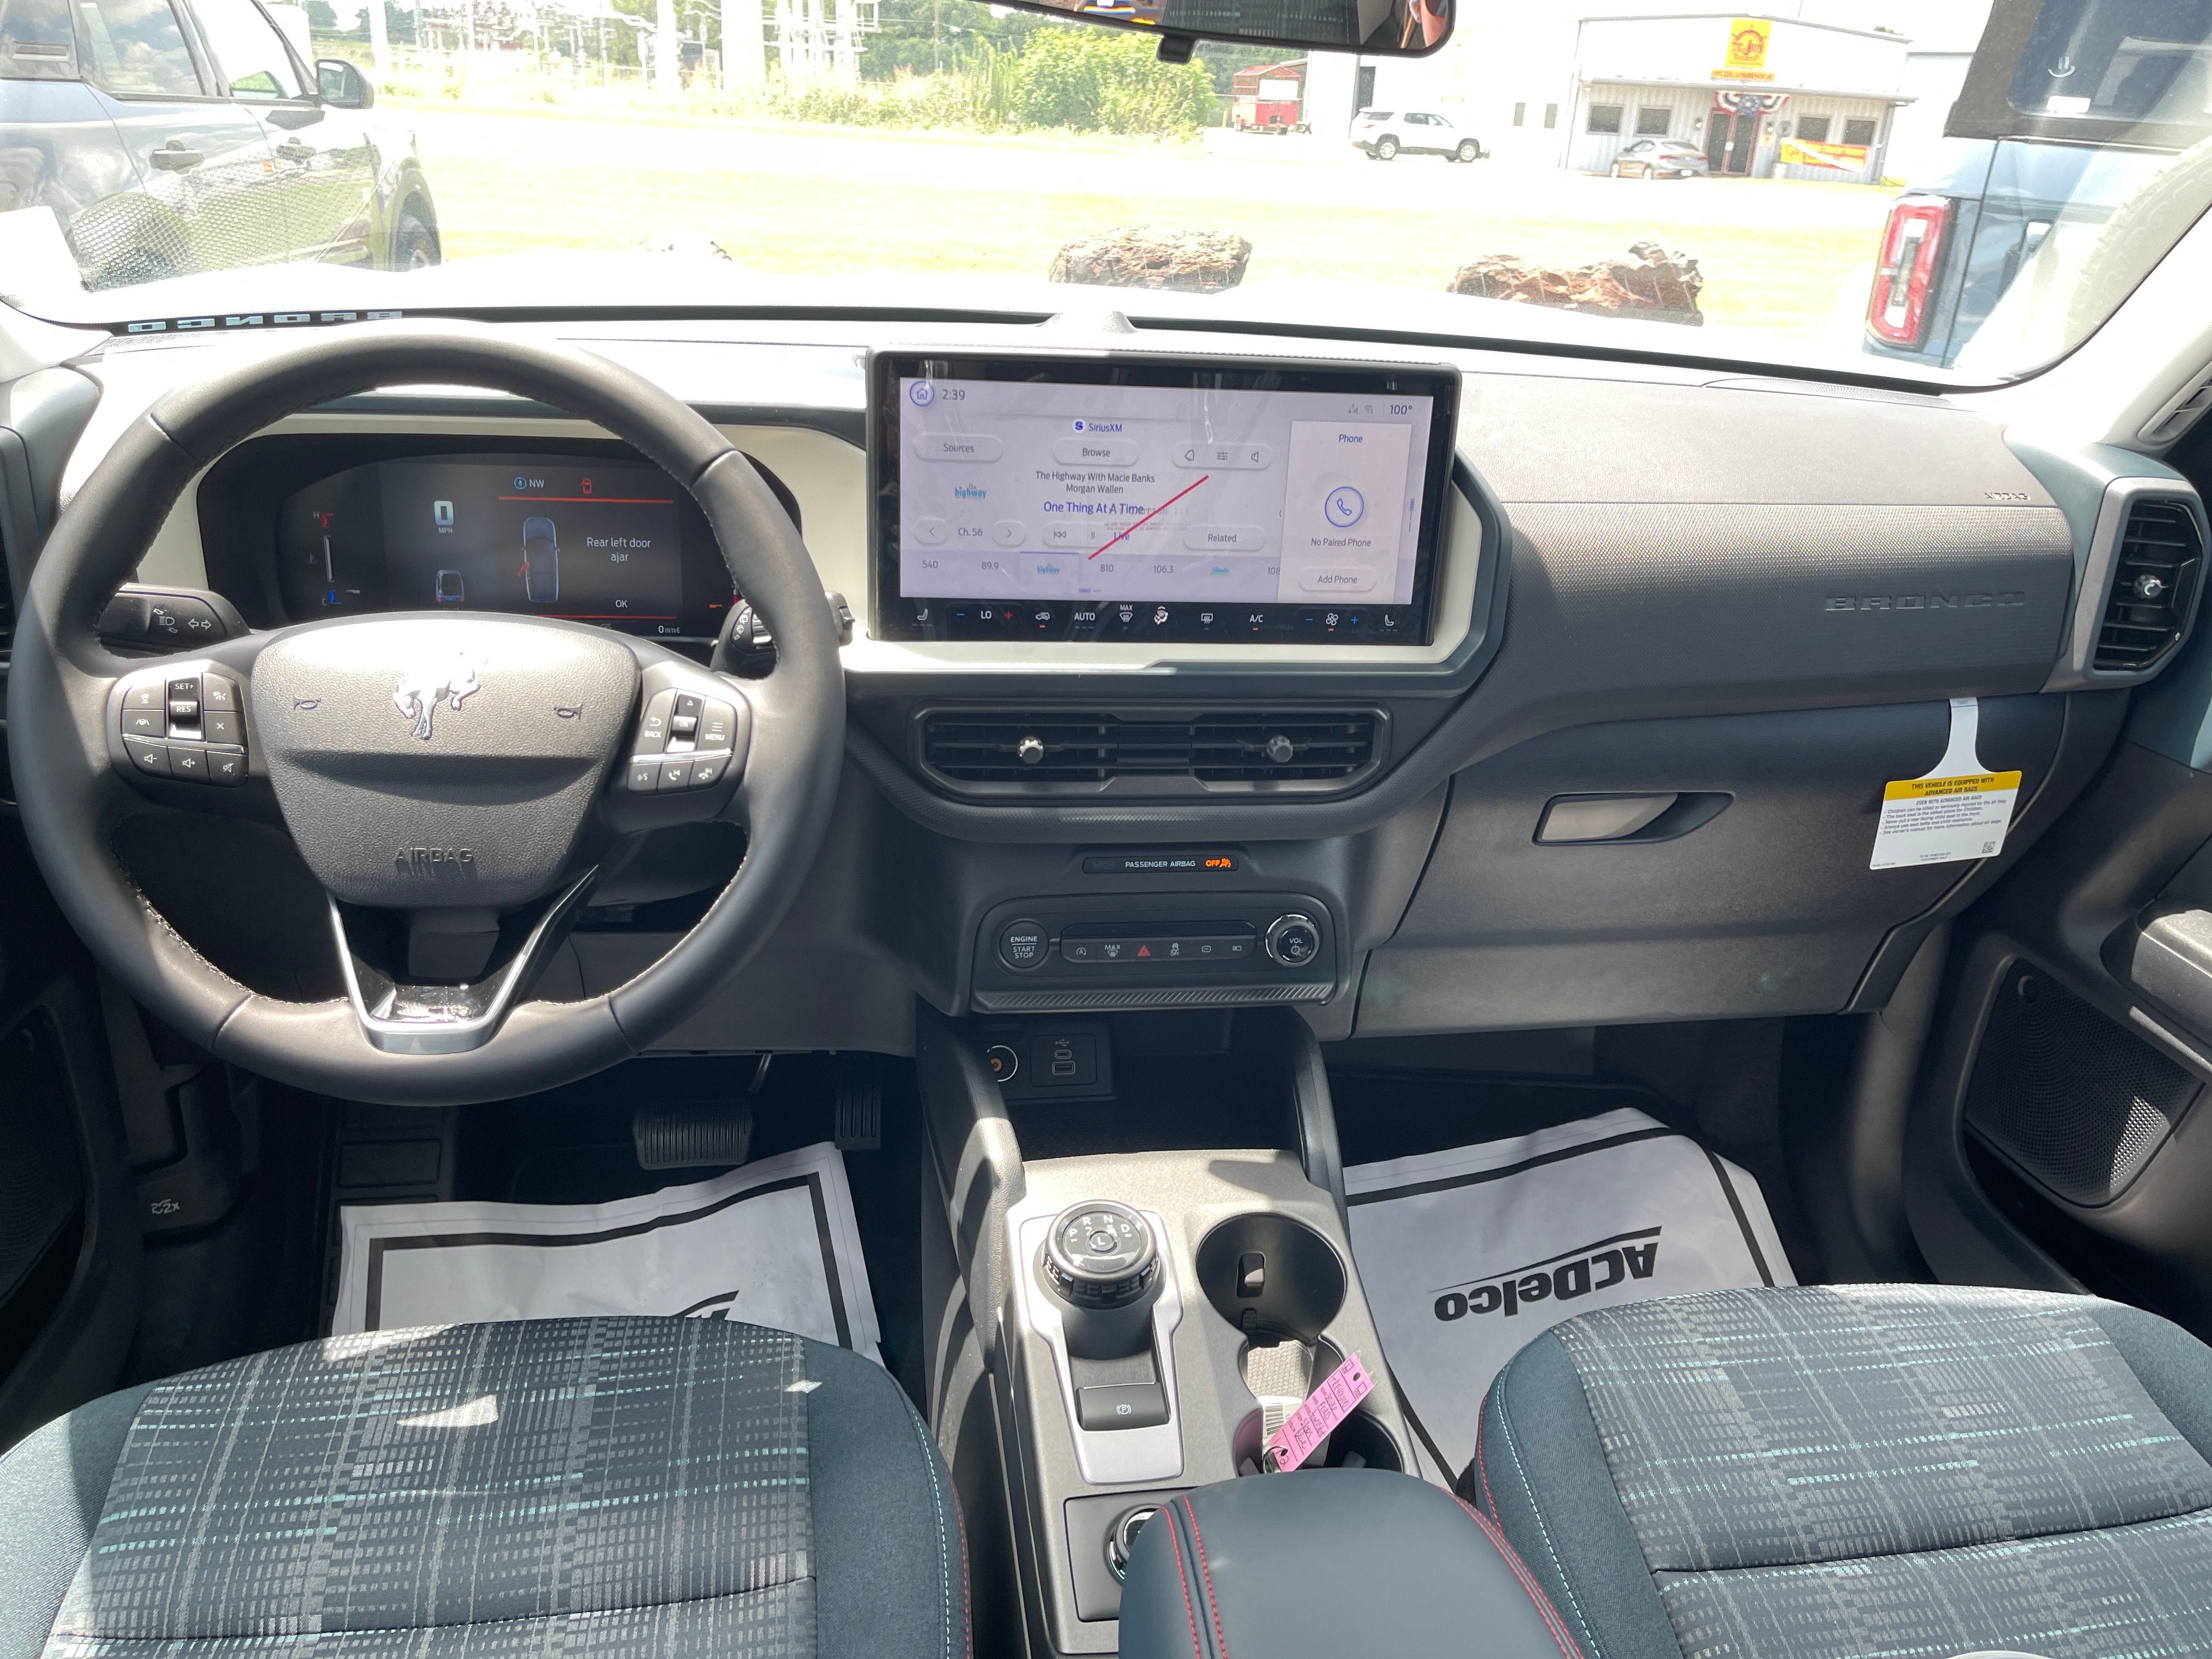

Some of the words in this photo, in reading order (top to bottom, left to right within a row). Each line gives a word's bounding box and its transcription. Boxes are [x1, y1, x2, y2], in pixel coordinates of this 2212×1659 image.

[942, 389, 966, 400] 2:39
[1088, 424, 1122, 432] SiriusXM
[1339, 434, 1363, 443] Phone
[943, 443, 974, 453] Sources
[1082, 448, 1110, 457] Browse
[1035, 471, 1051, 480] The
[1052, 472, 1086, 482] Highway
[1087, 472, 1106, 482] With
[1108, 473, 1130, 482] Macie
[1131, 474, 1155, 483] Banks
[529, 479, 544, 488] NW
[1066, 484, 1096, 494] Morgan
[1097, 484, 1124, 494] Wallen
[1043, 501, 1064, 512] One
[1066, 502, 1093, 515] Thing
[1096, 503, 1108, 514] At
[1111, 503, 1118, 514] A
[1119, 503, 1144, 514] Time
[958, 528, 970, 537] Ch.
[972, 528, 983, 537] 56
[587, 537, 608, 547] Rear
[611, 537, 627, 548] left
[629, 538, 651, 548] door
[1207, 533, 1237, 543] Related
[1311, 538, 1322, 546] No
[1323, 538, 1347, 546] Paired
[1348, 539, 1372, 547] Phone
[611, 552, 629, 563] ajar
[922, 561, 939, 569] 540
[981, 561, 999, 570] 89.9
[1100, 564, 1114, 573] 810
[1153, 565, 1173, 573] 106.3
[1318, 575, 1333, 584] Add
[1334, 575, 1357, 584] Phone
[616, 600, 628, 608] OK
[1826, 591, 2024, 612] BRONCO
[981, 611, 992, 619] LO
[1074, 612, 1095, 621] AUTO
[1250, 614, 1263, 623] A/C
[394, 847, 475, 864] AIRBAG
[1082, 1216, 1092, 1225] R
[1103, 1215, 1113, 1223] N
[1069, 1228, 1077, 1237] P
[1121, 1224, 1130, 1233] D
[1097, 1237, 1105, 1245] L
[1434, 1242, 1658, 1322] ACDelco
